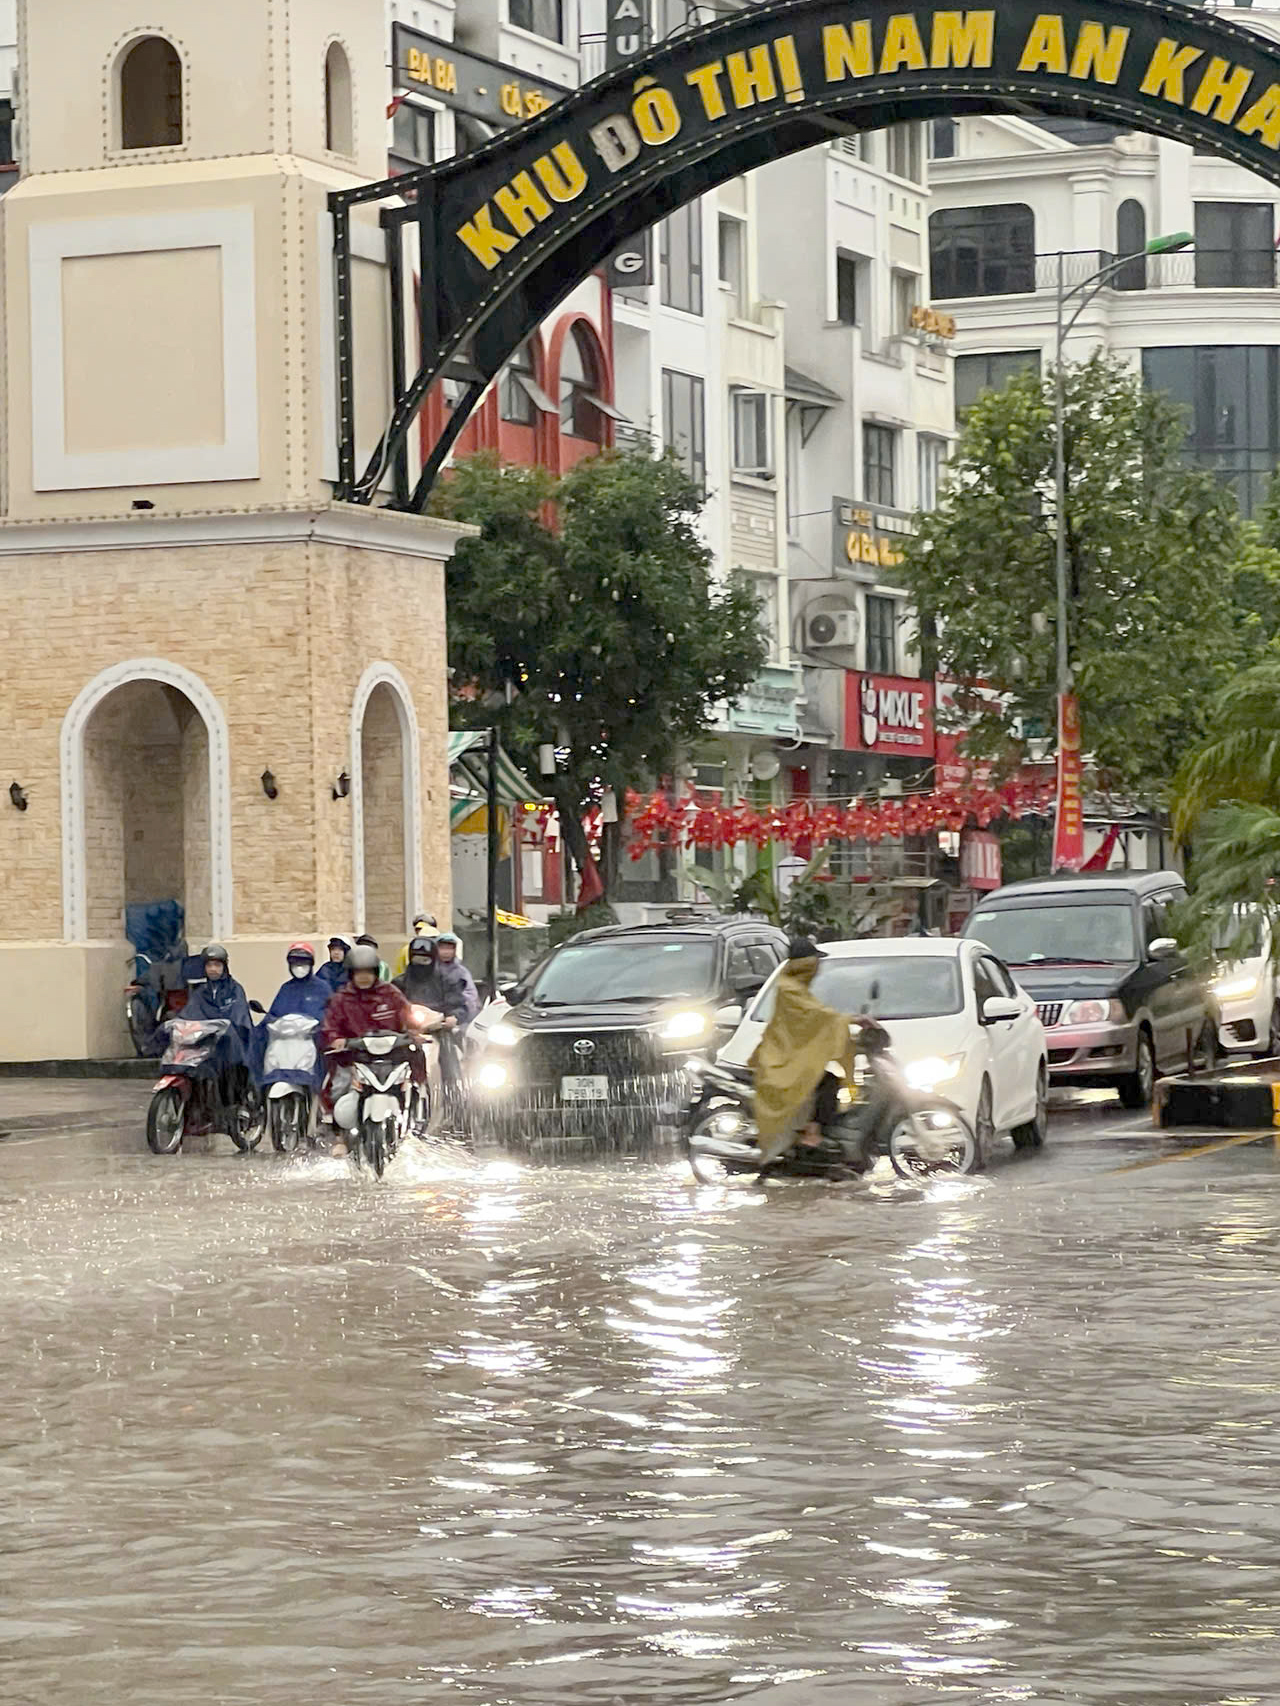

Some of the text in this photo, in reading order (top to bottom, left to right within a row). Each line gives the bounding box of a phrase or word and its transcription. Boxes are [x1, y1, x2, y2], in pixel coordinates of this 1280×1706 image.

[408, 47, 432, 85] BA
[435, 57, 457, 94] BA
[456, 140, 588, 271] KHU
[589, 75, 681, 173] ĐÔ
[686, 35, 805, 121] THỊ
[823, 10, 995, 82] NAM
[1017, 14, 1130, 85] AN
[879, 689, 924, 729] MIXUE
